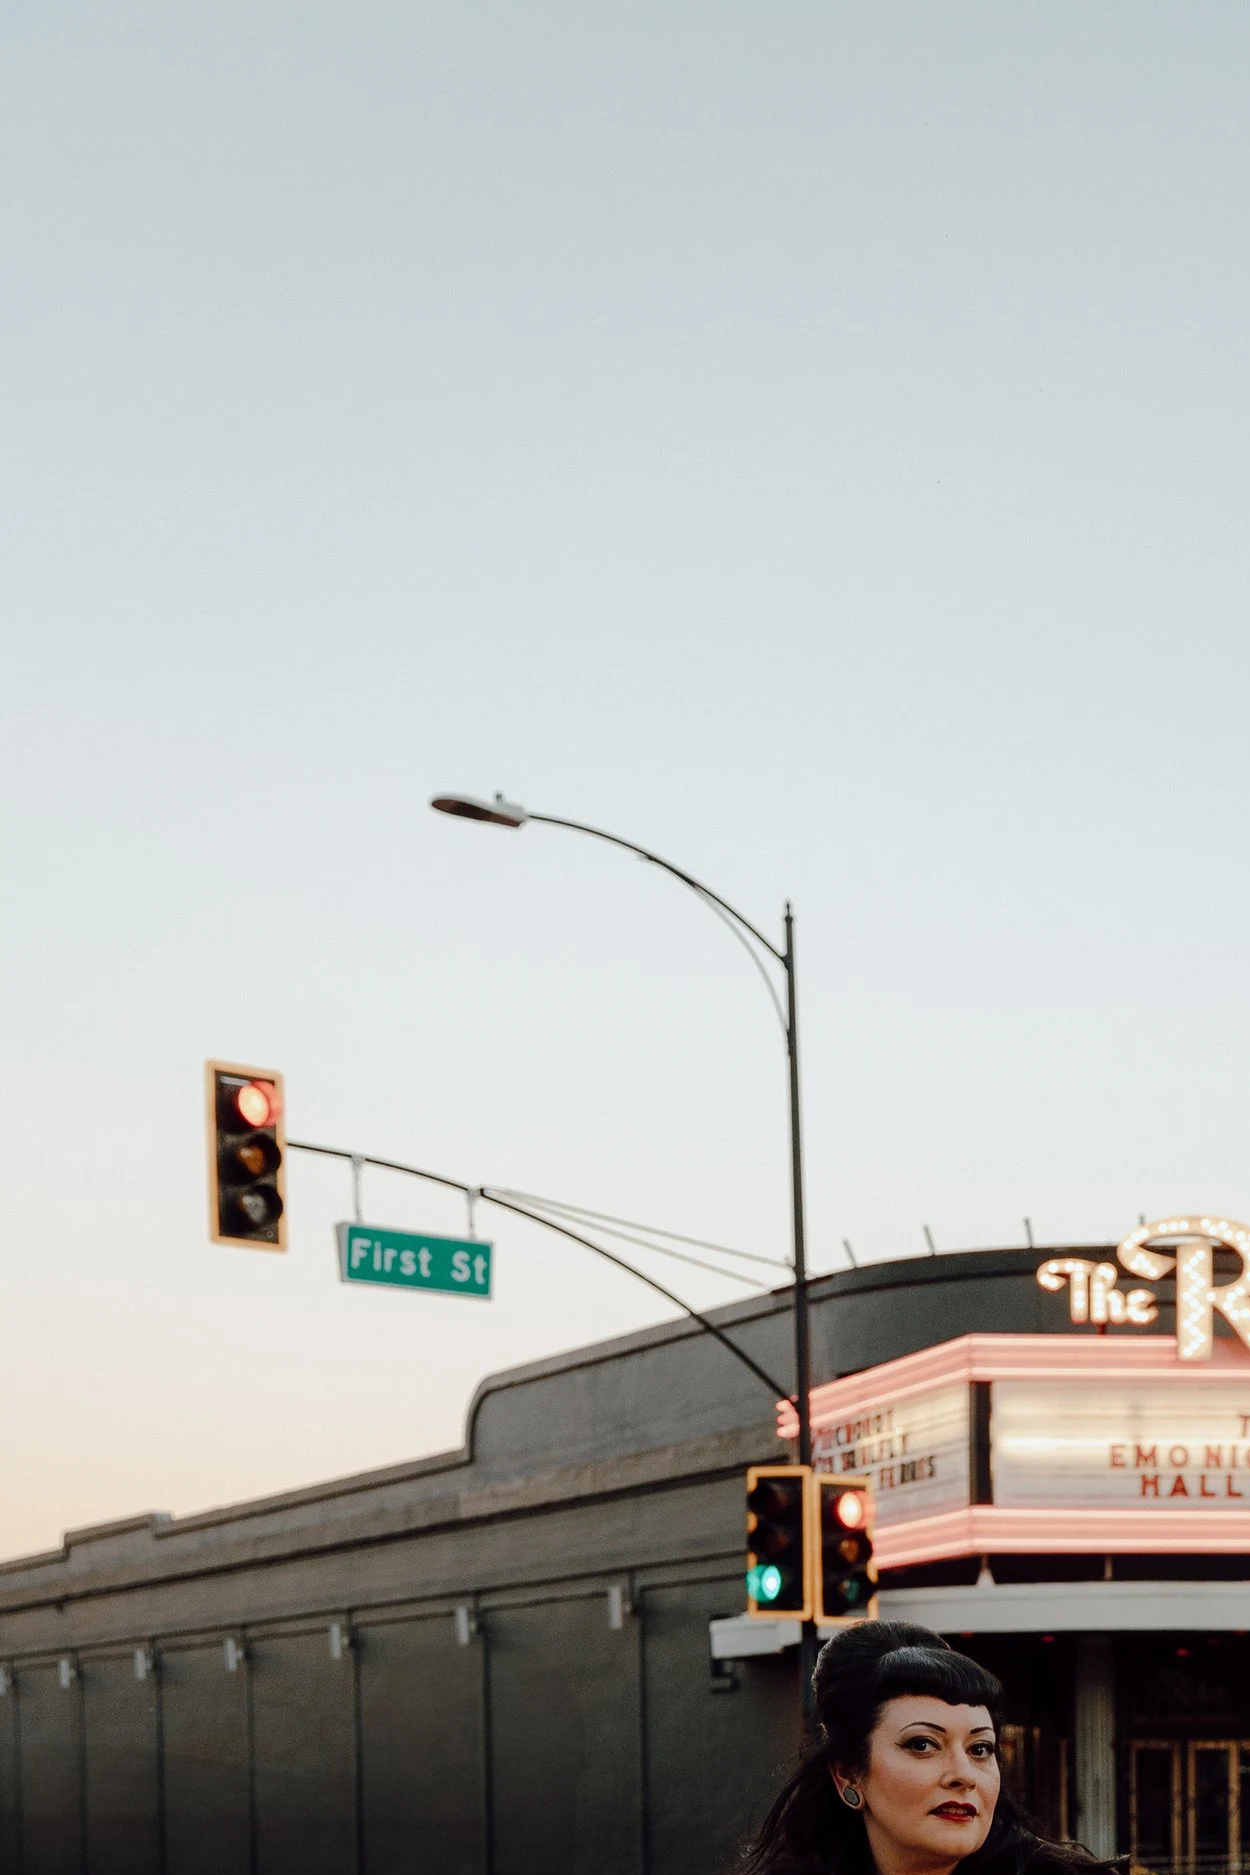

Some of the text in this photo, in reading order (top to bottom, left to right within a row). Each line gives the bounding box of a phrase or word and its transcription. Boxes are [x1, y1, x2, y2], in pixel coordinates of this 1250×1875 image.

[351, 1237, 488, 1285] First St
[1036, 1257, 1158, 1326] The
[1110, 1444, 1190, 1469] EMO
